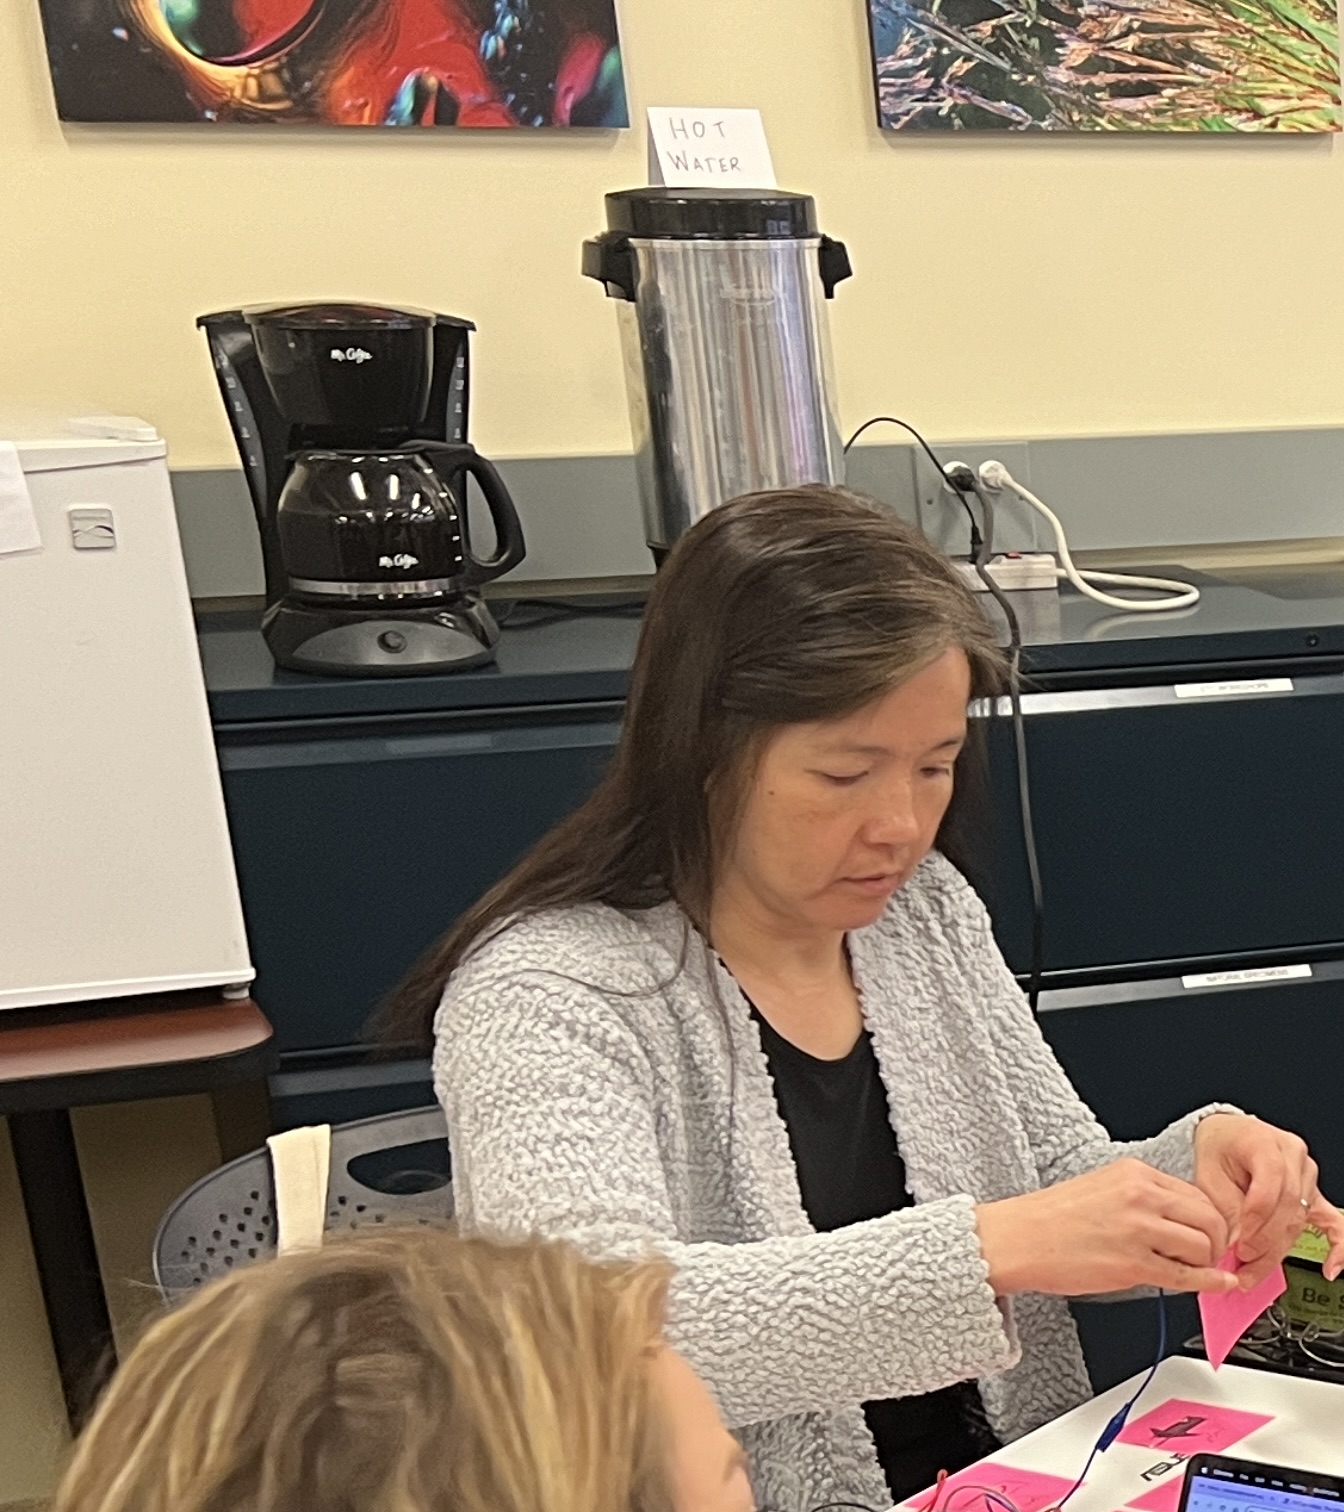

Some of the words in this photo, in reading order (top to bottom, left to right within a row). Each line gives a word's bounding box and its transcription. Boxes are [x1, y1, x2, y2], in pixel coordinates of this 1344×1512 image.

[669, 117, 725, 139] HOT
[666, 150, 741, 173] WATER
[1303, 1287, 1331, 1305] Be
